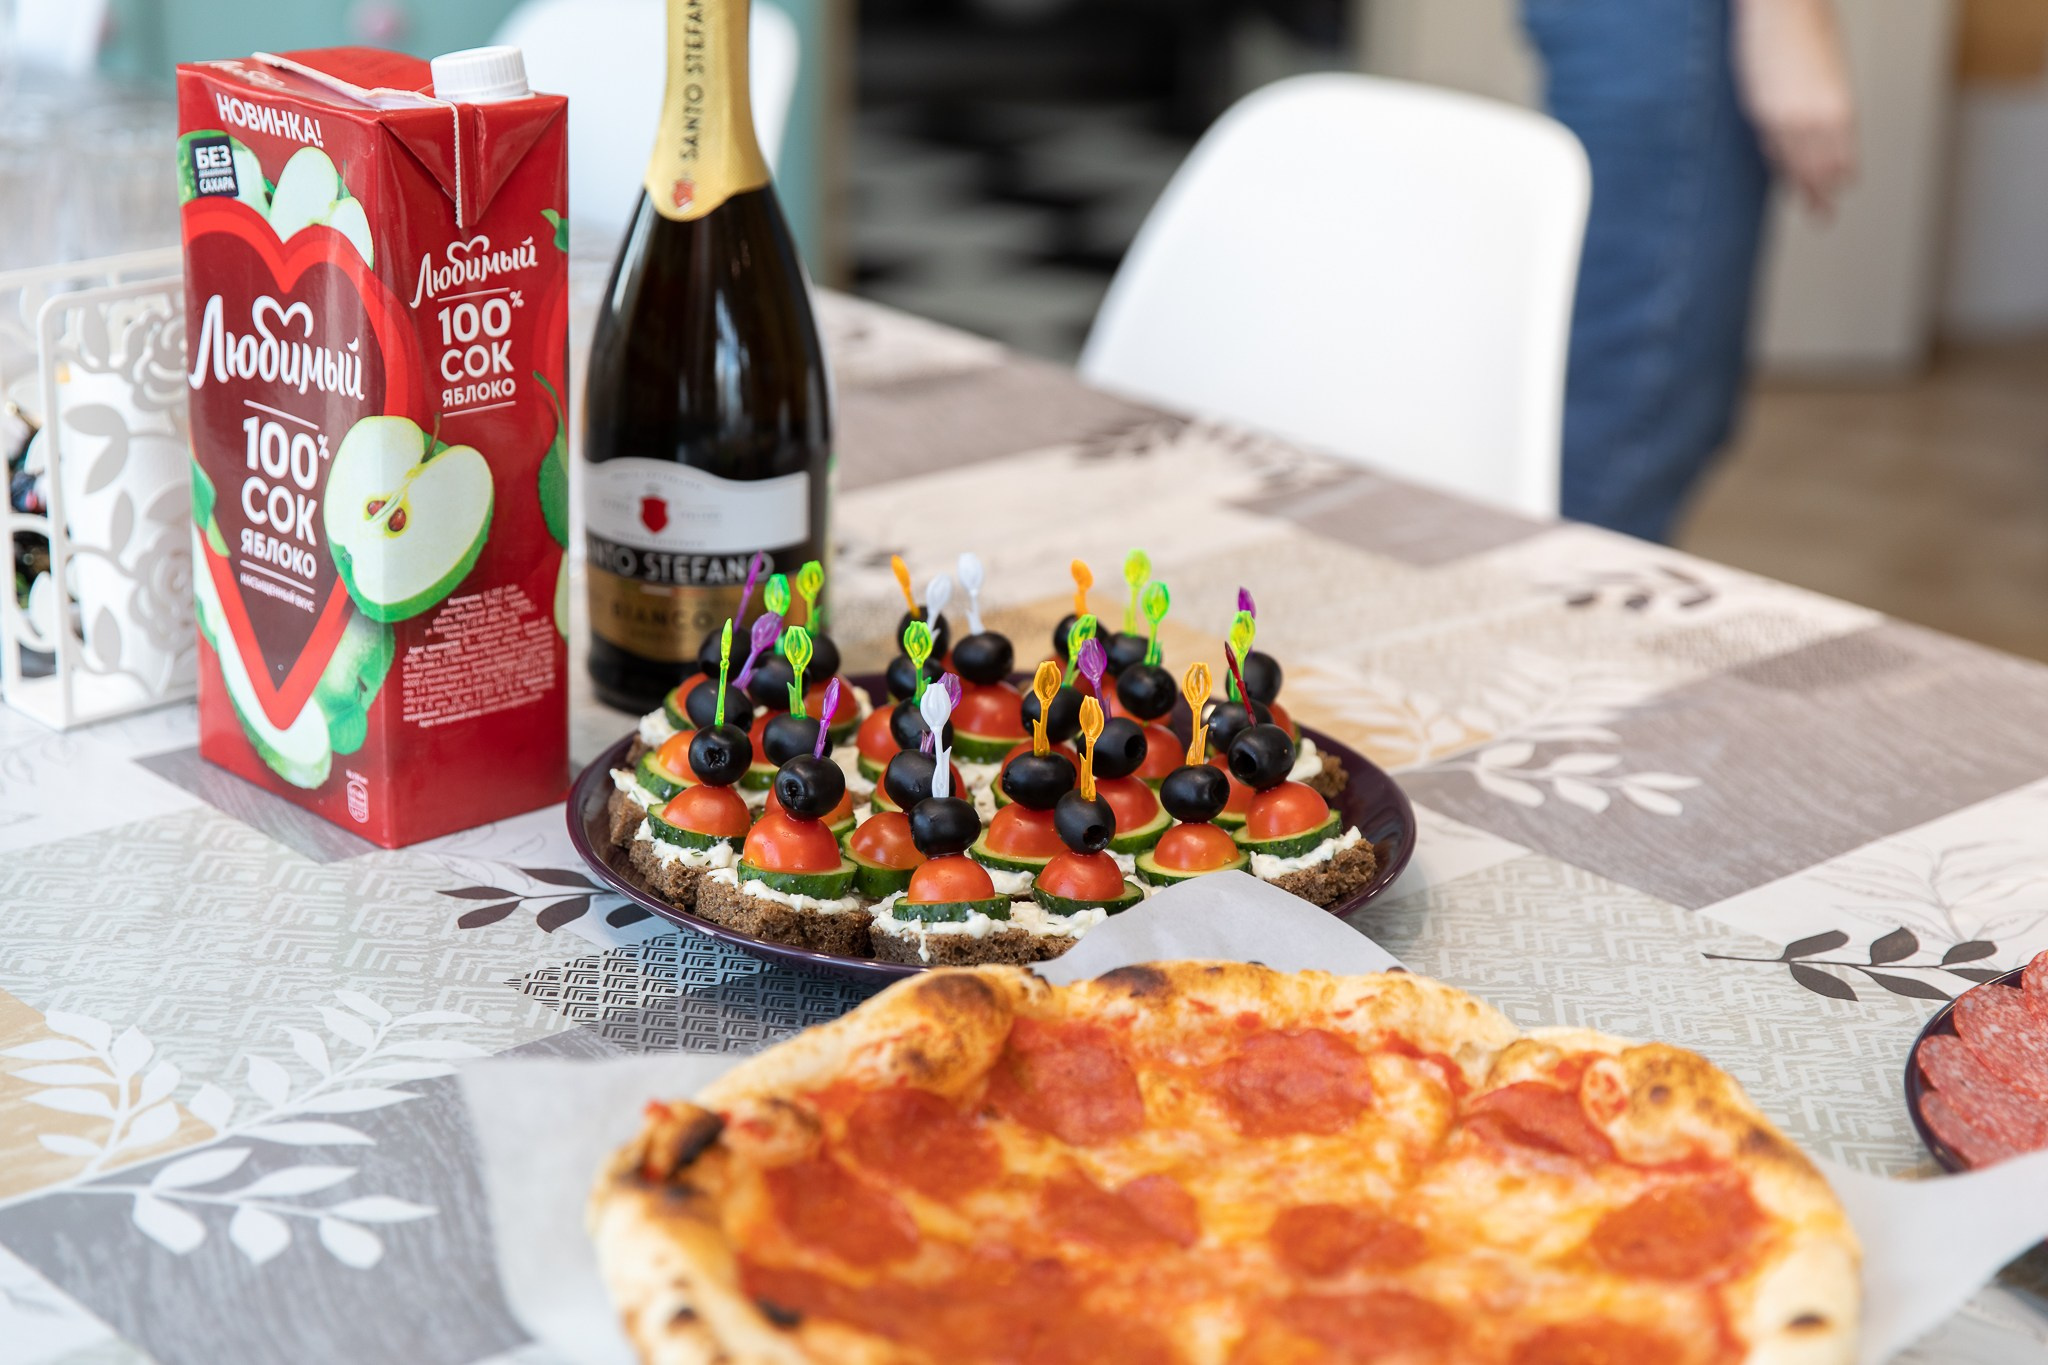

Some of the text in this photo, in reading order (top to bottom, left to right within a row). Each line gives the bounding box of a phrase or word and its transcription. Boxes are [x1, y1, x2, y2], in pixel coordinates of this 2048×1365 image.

[215, 92, 324, 148] НОВИНКА!
[679, 83, 704, 162] SANTO
[195, 145, 232, 169] БЕЗ
[199, 175, 236, 194] САХАРА
[409, 235, 539, 309] Любимый
[438, 290, 525, 346] 100%
[187, 294, 366, 401] Любимый
[440, 339, 515, 383] СОК
[442, 377, 517, 408] ЯБЛОКО
[243, 416, 330, 491] 100%
[241, 476, 318, 547] СОК
[240, 527, 317, 580] ЯБЛОКО
[643, 552, 775, 584] STEFANO
[240, 571, 316, 613] НАСЫЩЕННЫЙ ВКУС
